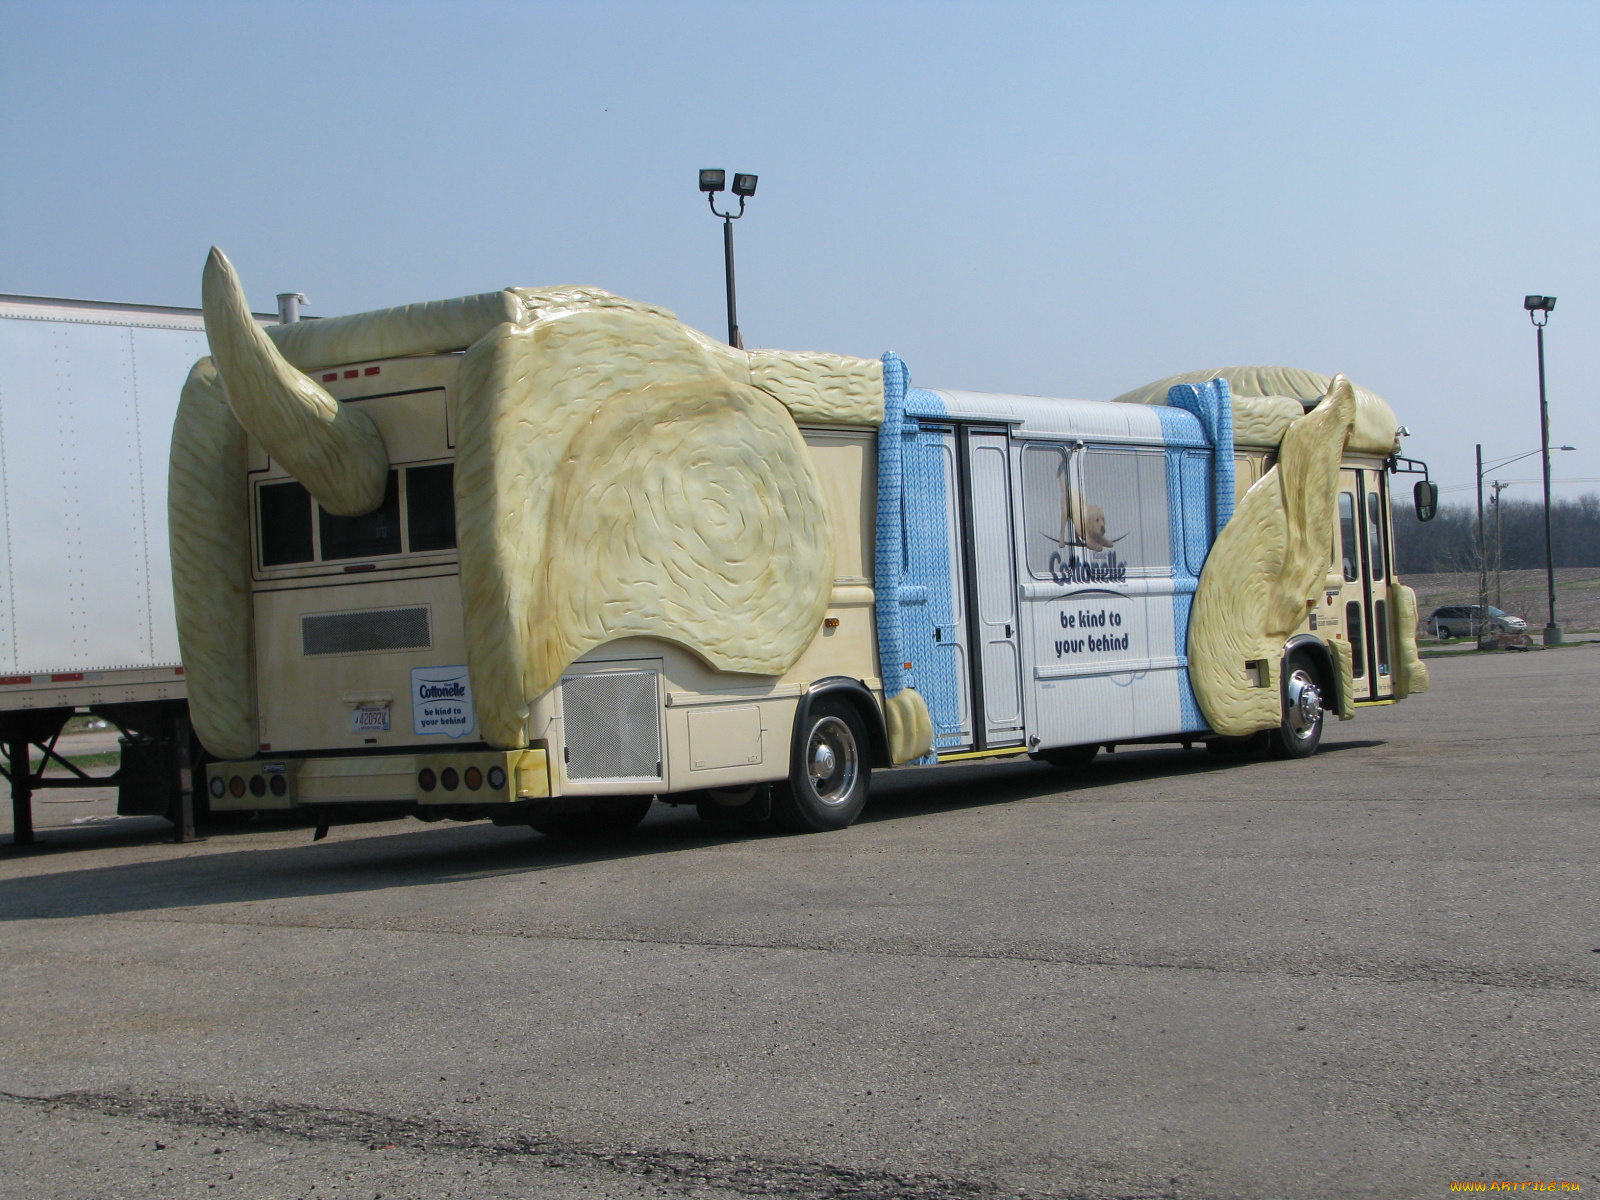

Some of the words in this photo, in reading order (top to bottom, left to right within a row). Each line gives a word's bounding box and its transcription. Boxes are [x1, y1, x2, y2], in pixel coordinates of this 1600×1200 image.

[1049, 551, 1127, 586] Cottonelle
[1060, 610, 1075, 628] be
[1078, 610, 1105, 628] kind
[1109, 611, 1121, 626] to
[1055, 639, 1085, 658] your
[1088, 633, 1128, 652] behind
[420, 682, 466, 699] Cottonelle
[435, 707, 451, 715] kind
[421, 719, 439, 727] your
[441, 716, 466, 725] behind
